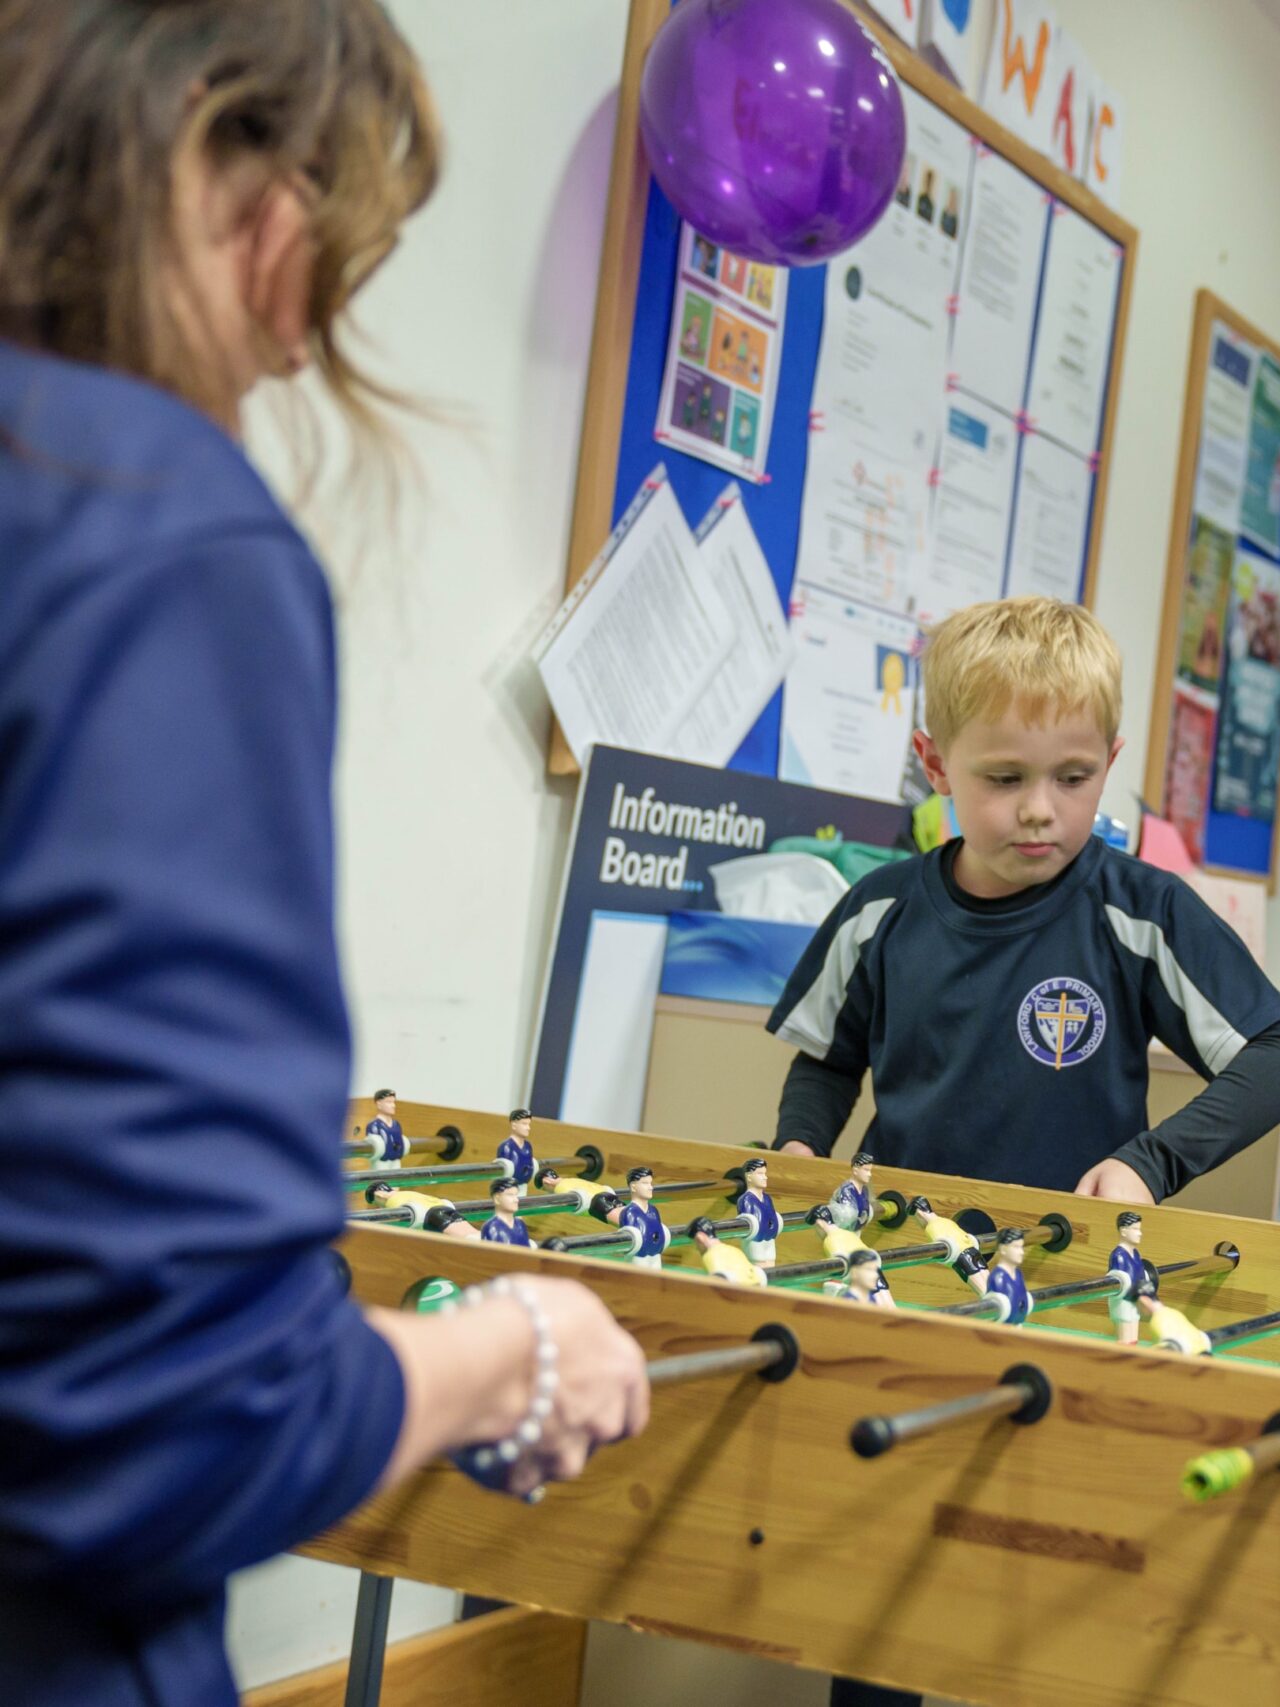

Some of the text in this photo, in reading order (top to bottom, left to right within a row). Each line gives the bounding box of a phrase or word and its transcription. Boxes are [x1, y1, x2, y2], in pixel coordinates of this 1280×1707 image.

[609, 782, 766, 850] Information
[1021, 980, 1103, 1056] LAWFORD C of E PRIMARY SCHOOL
